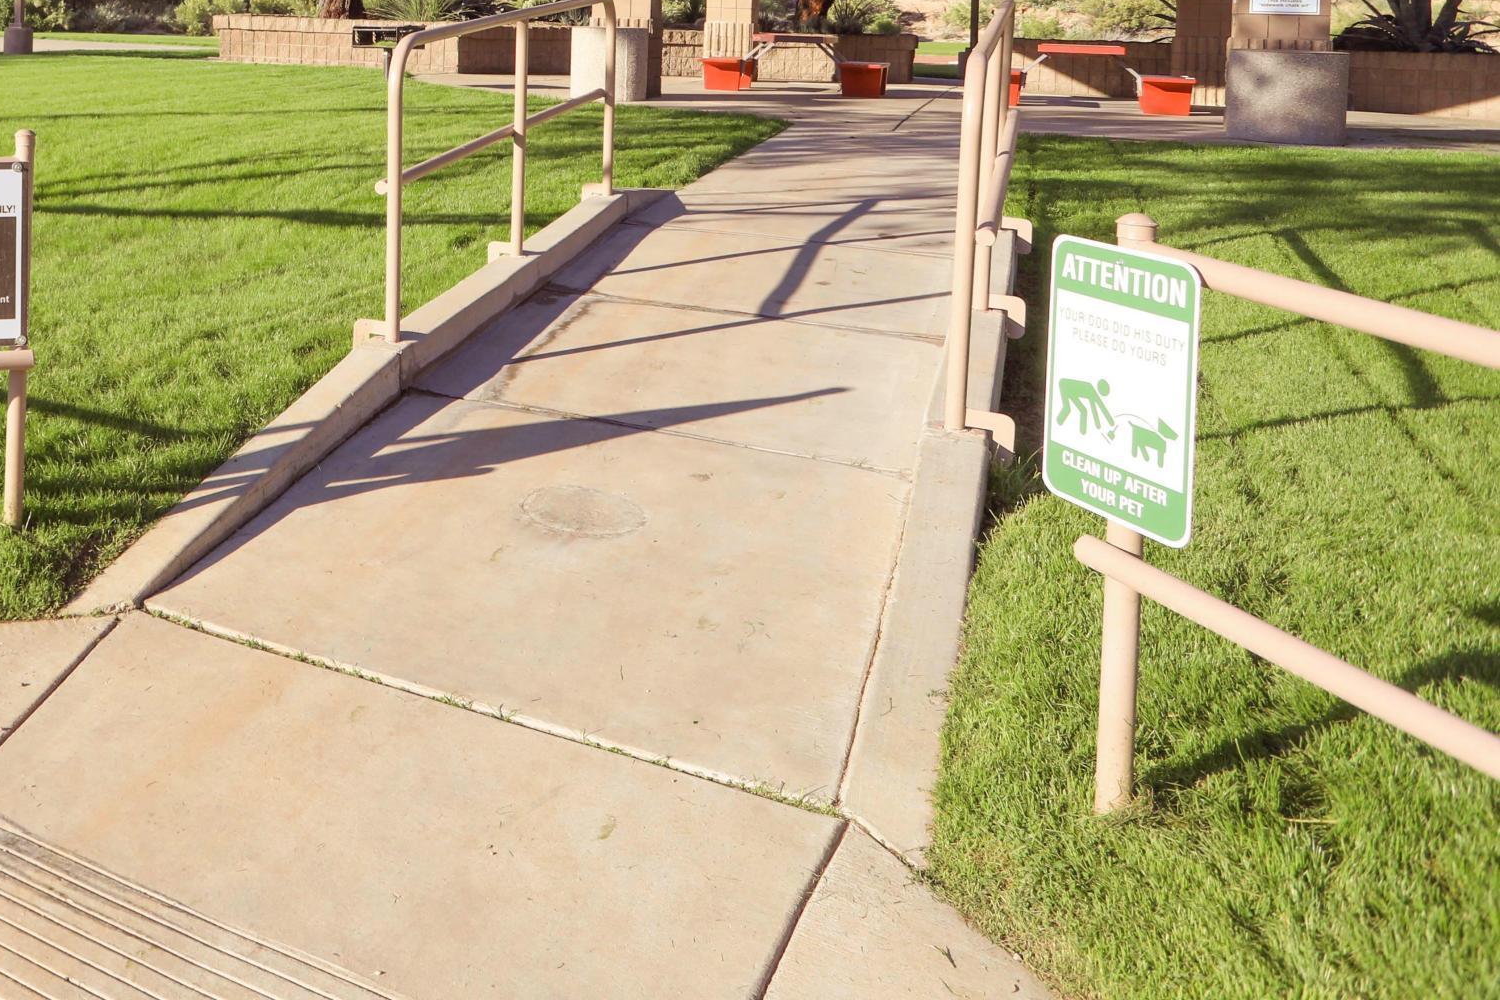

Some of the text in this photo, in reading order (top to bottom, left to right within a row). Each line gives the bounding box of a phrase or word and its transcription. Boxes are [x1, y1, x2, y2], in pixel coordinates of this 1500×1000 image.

[1061, 252, 1187, 308] ATTENTION
[1059, 305, 1085, 323] YOUR
[1112, 320, 1130, 337] DID
[1133, 328, 1150, 343] HIS
[1155, 334, 1186, 352] DUTY
[1072, 327, 1166, 367] PLEASE DO YOURS
[1062, 450, 1168, 507] CLEAN UP AFTER
[1080, 477, 1144, 519] YOUR PET
